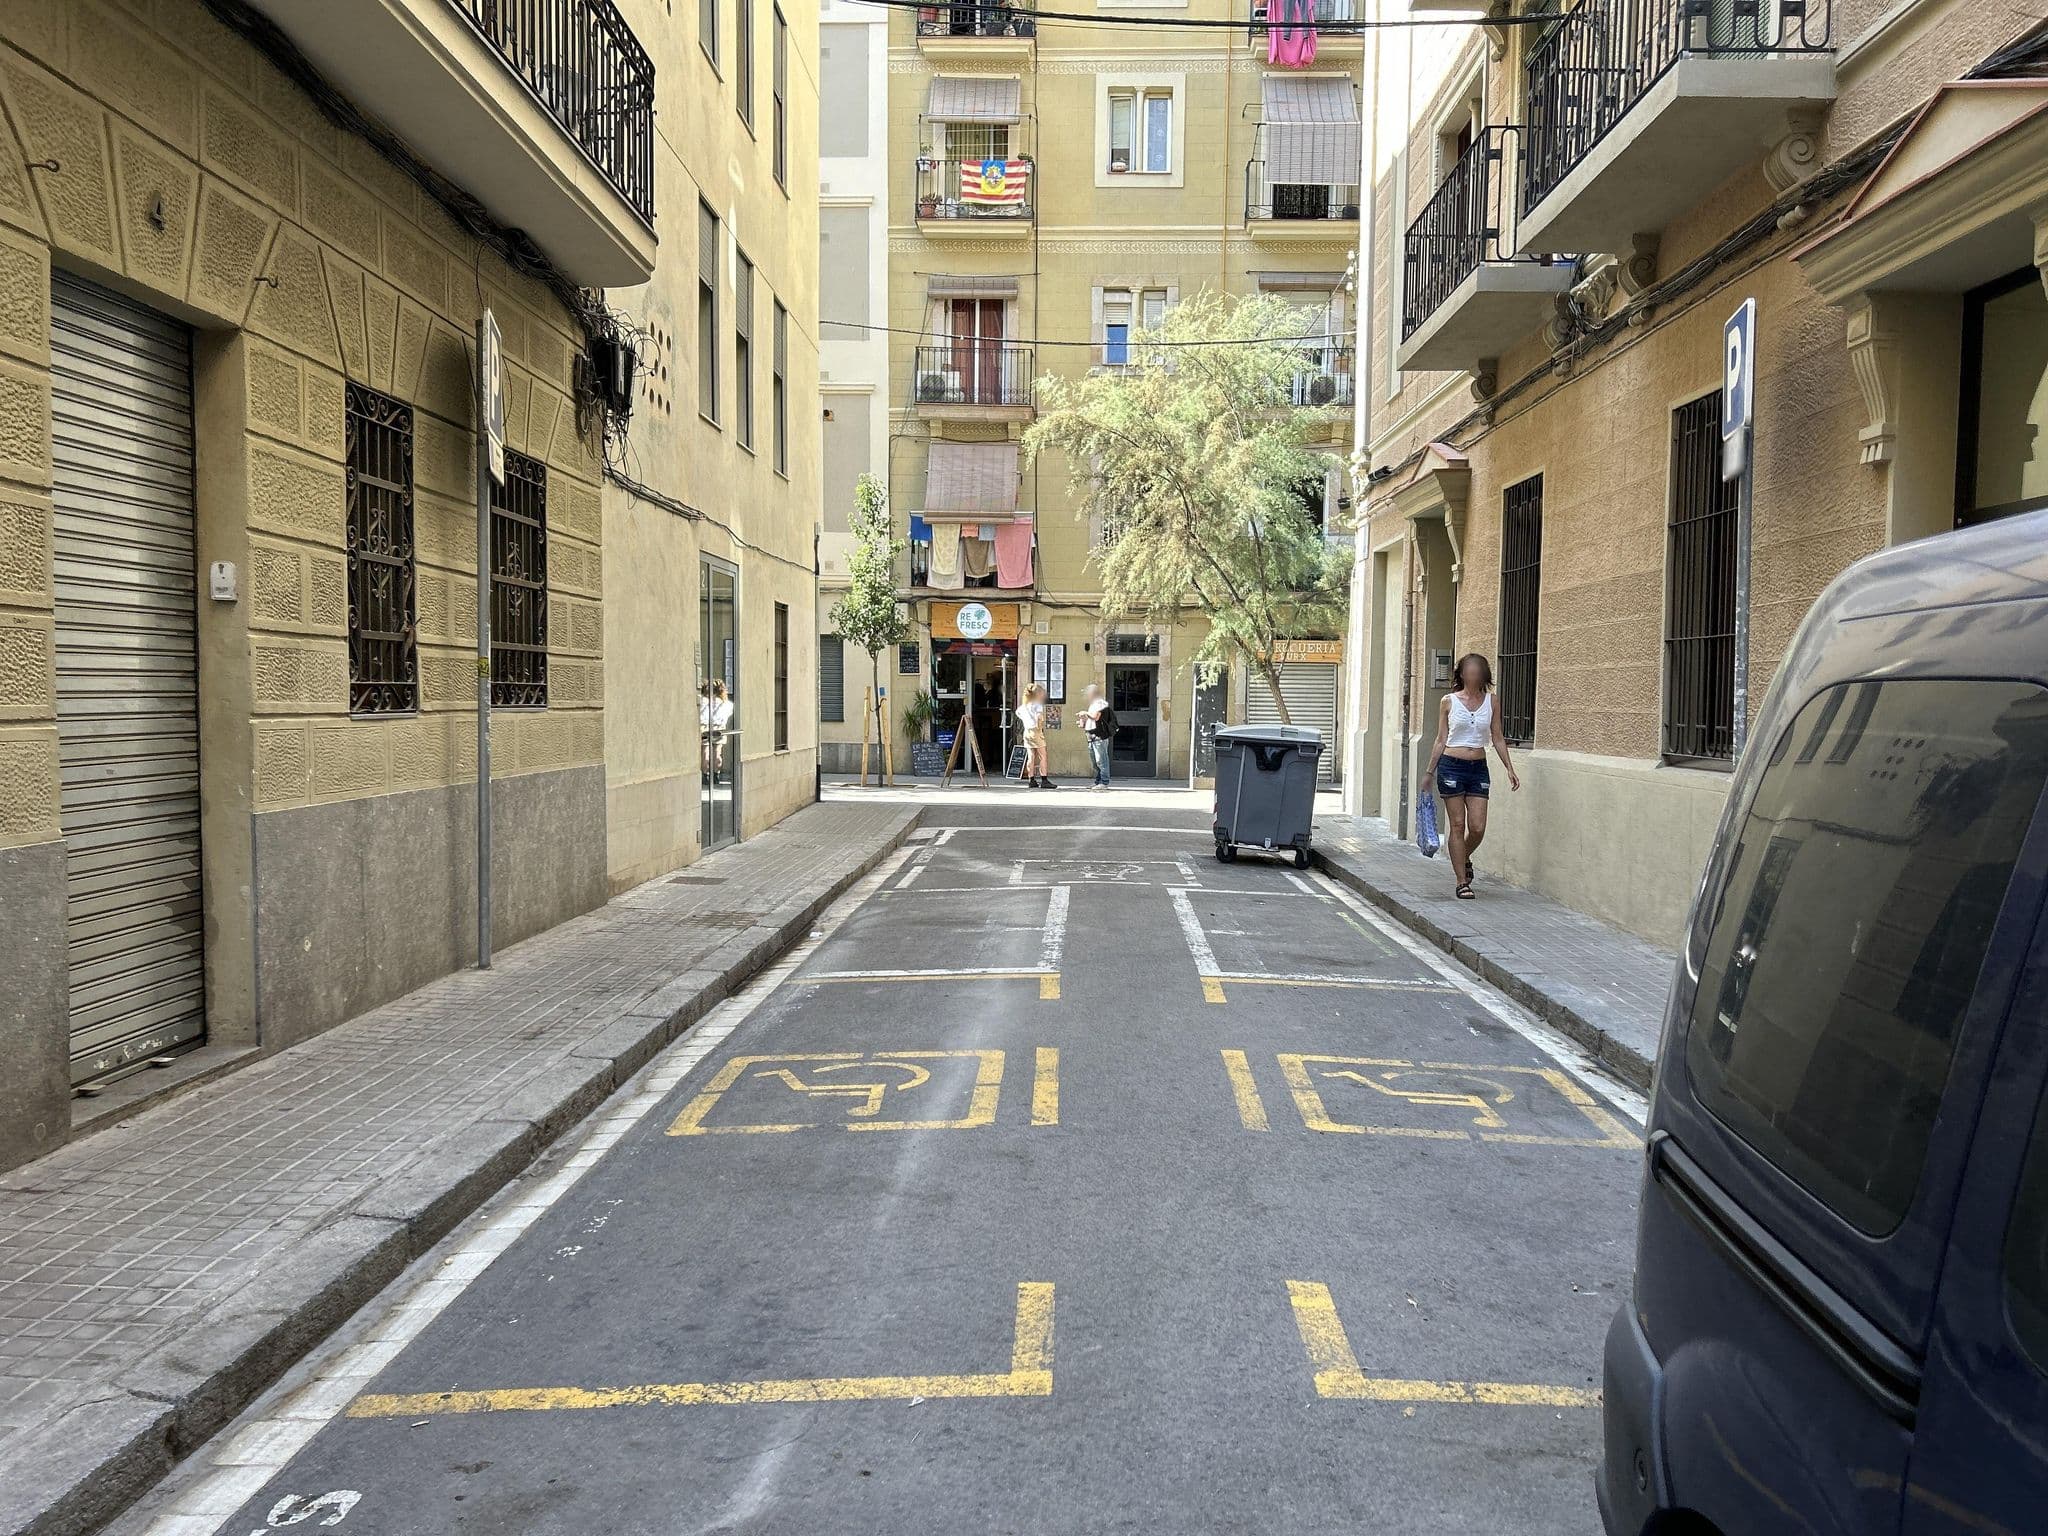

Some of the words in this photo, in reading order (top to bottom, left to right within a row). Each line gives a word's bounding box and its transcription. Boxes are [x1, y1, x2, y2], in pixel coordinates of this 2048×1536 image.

[491, 334, 500, 421] P
[1727, 325, 1742, 423] P
[960, 612, 972, 621] RE
[960, 621, 989, 630] FRESC
